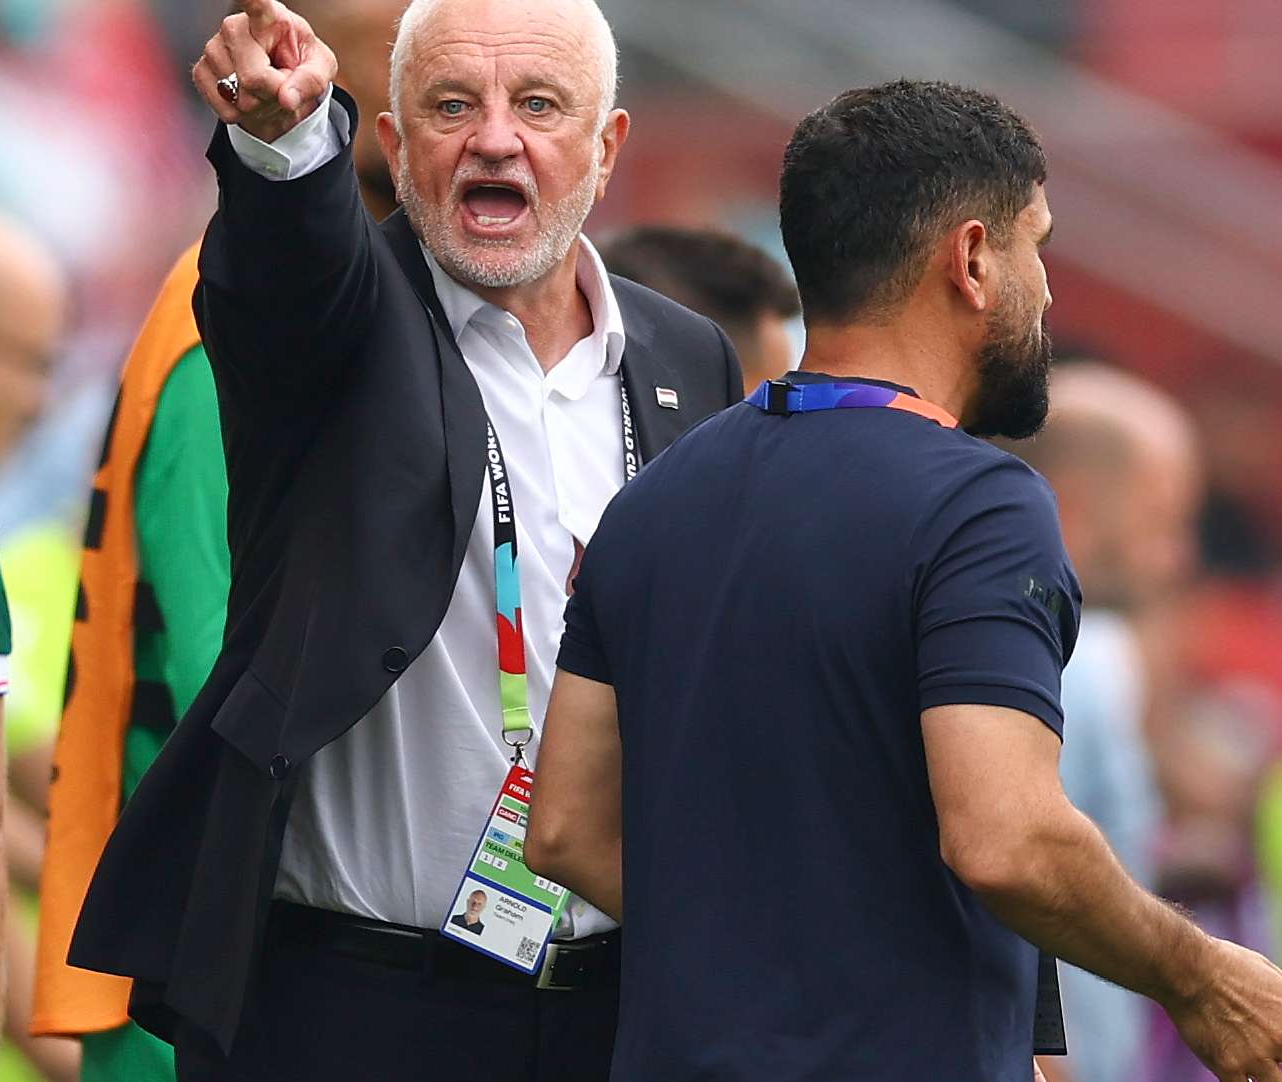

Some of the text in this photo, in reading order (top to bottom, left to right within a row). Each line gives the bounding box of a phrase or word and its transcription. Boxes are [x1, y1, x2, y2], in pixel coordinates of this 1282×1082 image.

[626, 453, 637, 481] CU
[496, 482, 511, 523] FIFA
[484, 841, 505, 857] TEAM
[495, 904, 524, 920] Graham
[499, 896, 528, 912] ARNOLD
